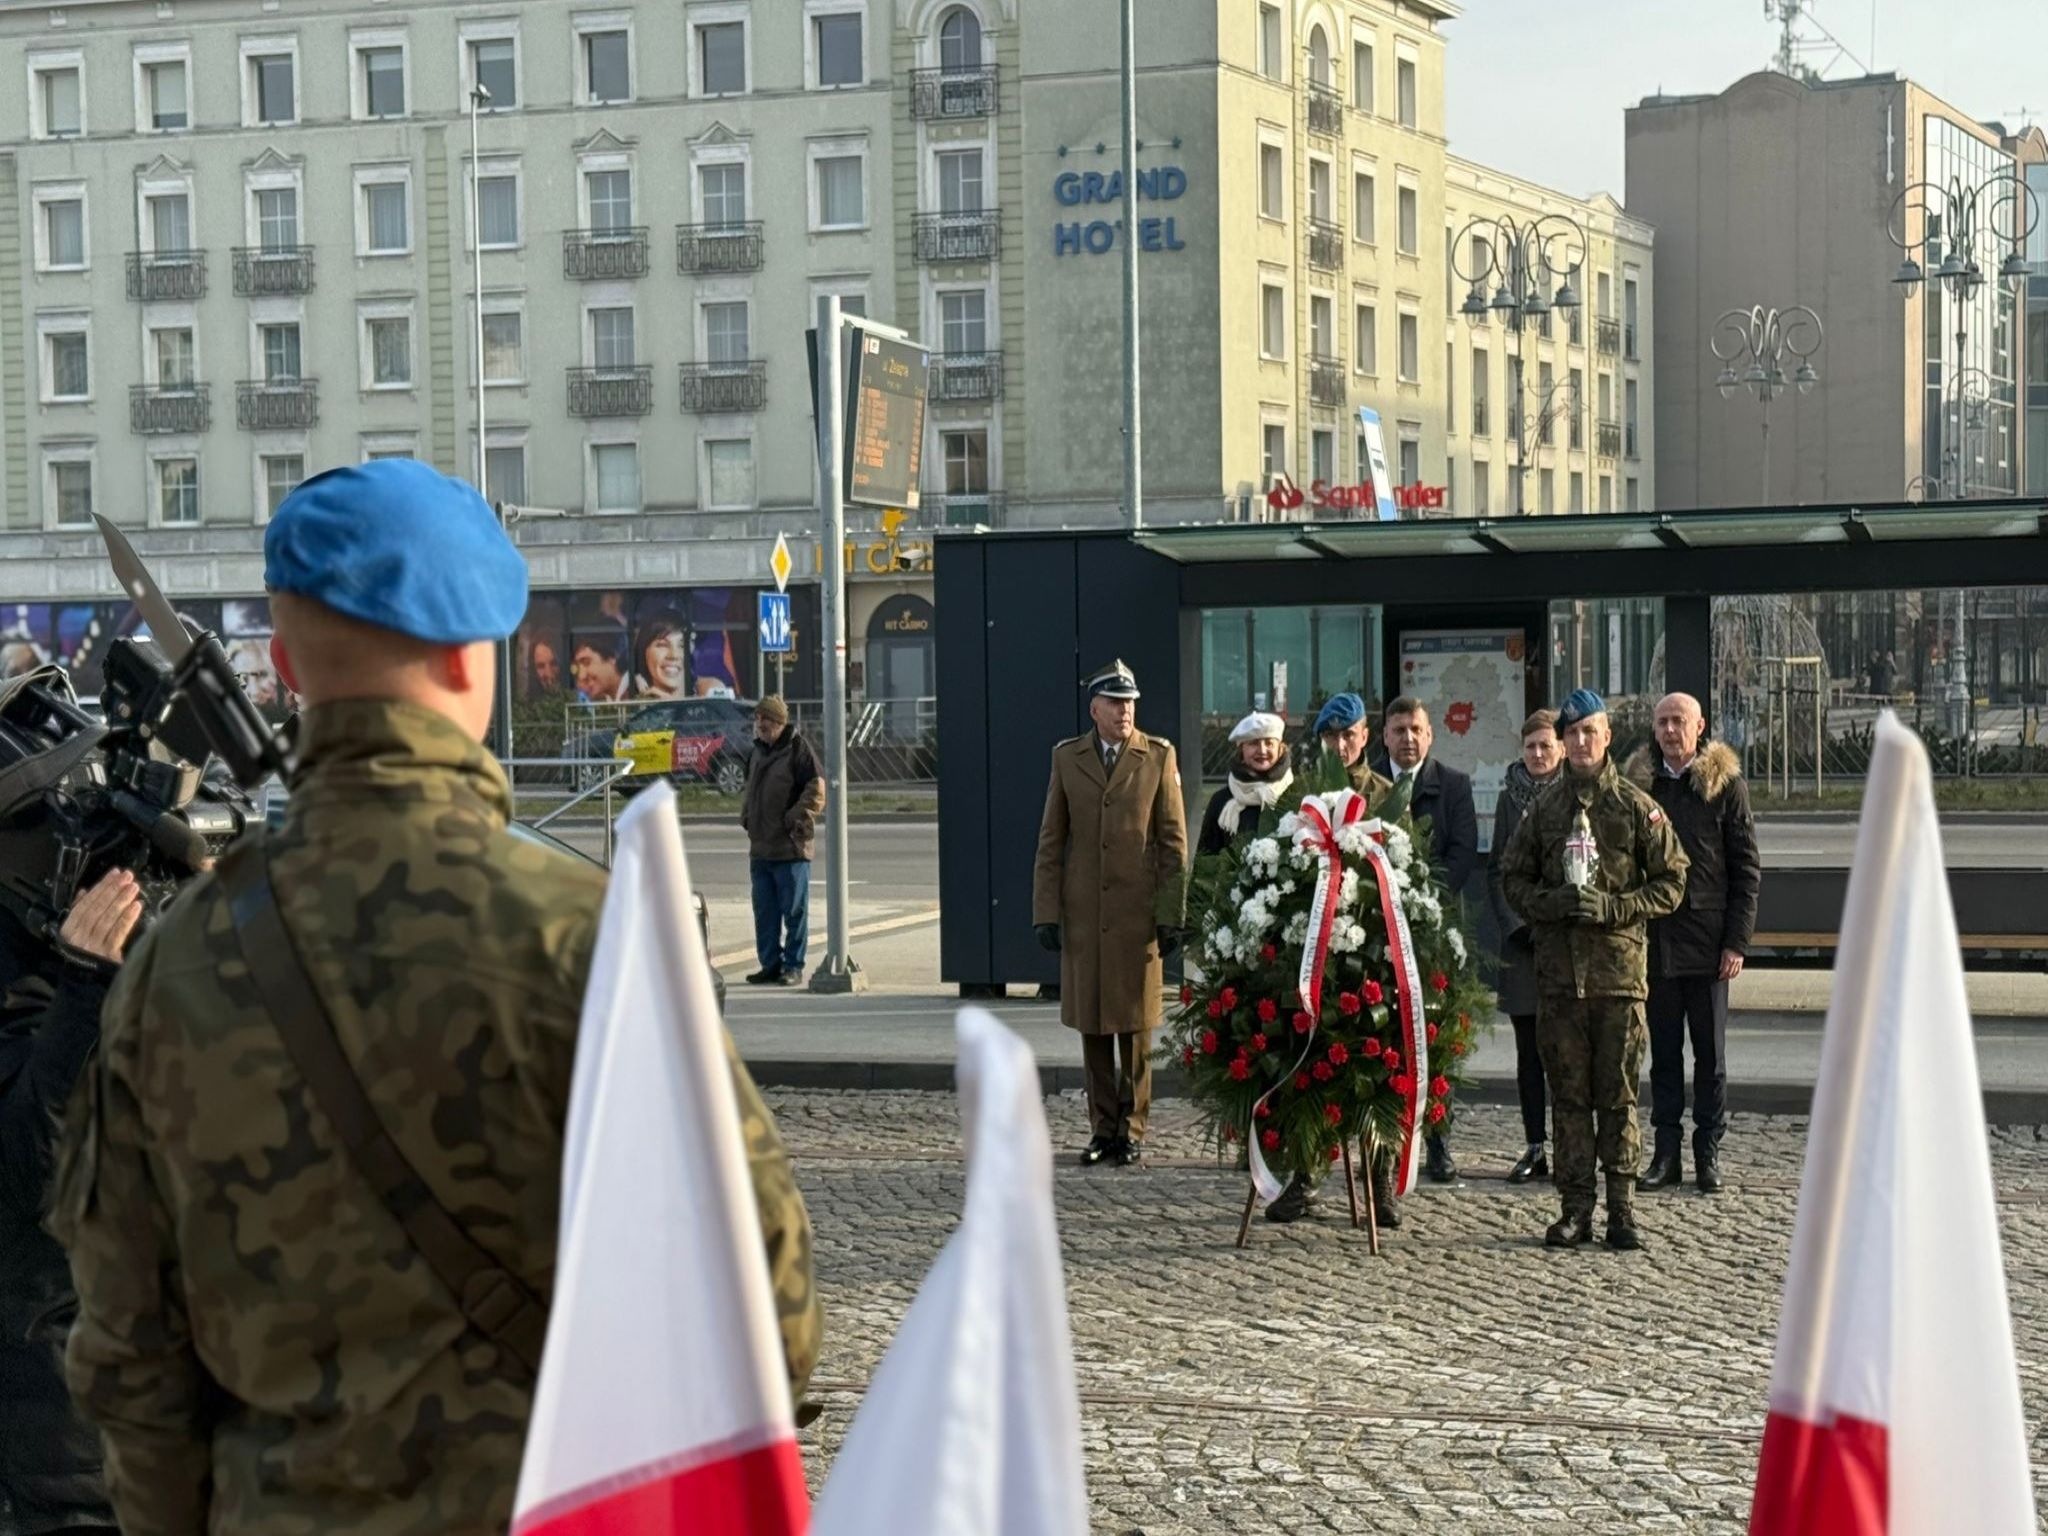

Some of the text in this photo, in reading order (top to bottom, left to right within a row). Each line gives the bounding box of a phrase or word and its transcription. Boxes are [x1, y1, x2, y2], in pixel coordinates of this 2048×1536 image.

[1054, 166, 1187, 206] GRAND
[1055, 217, 1186, 257] HOEL
[1310, 479, 1447, 509] Santnder
